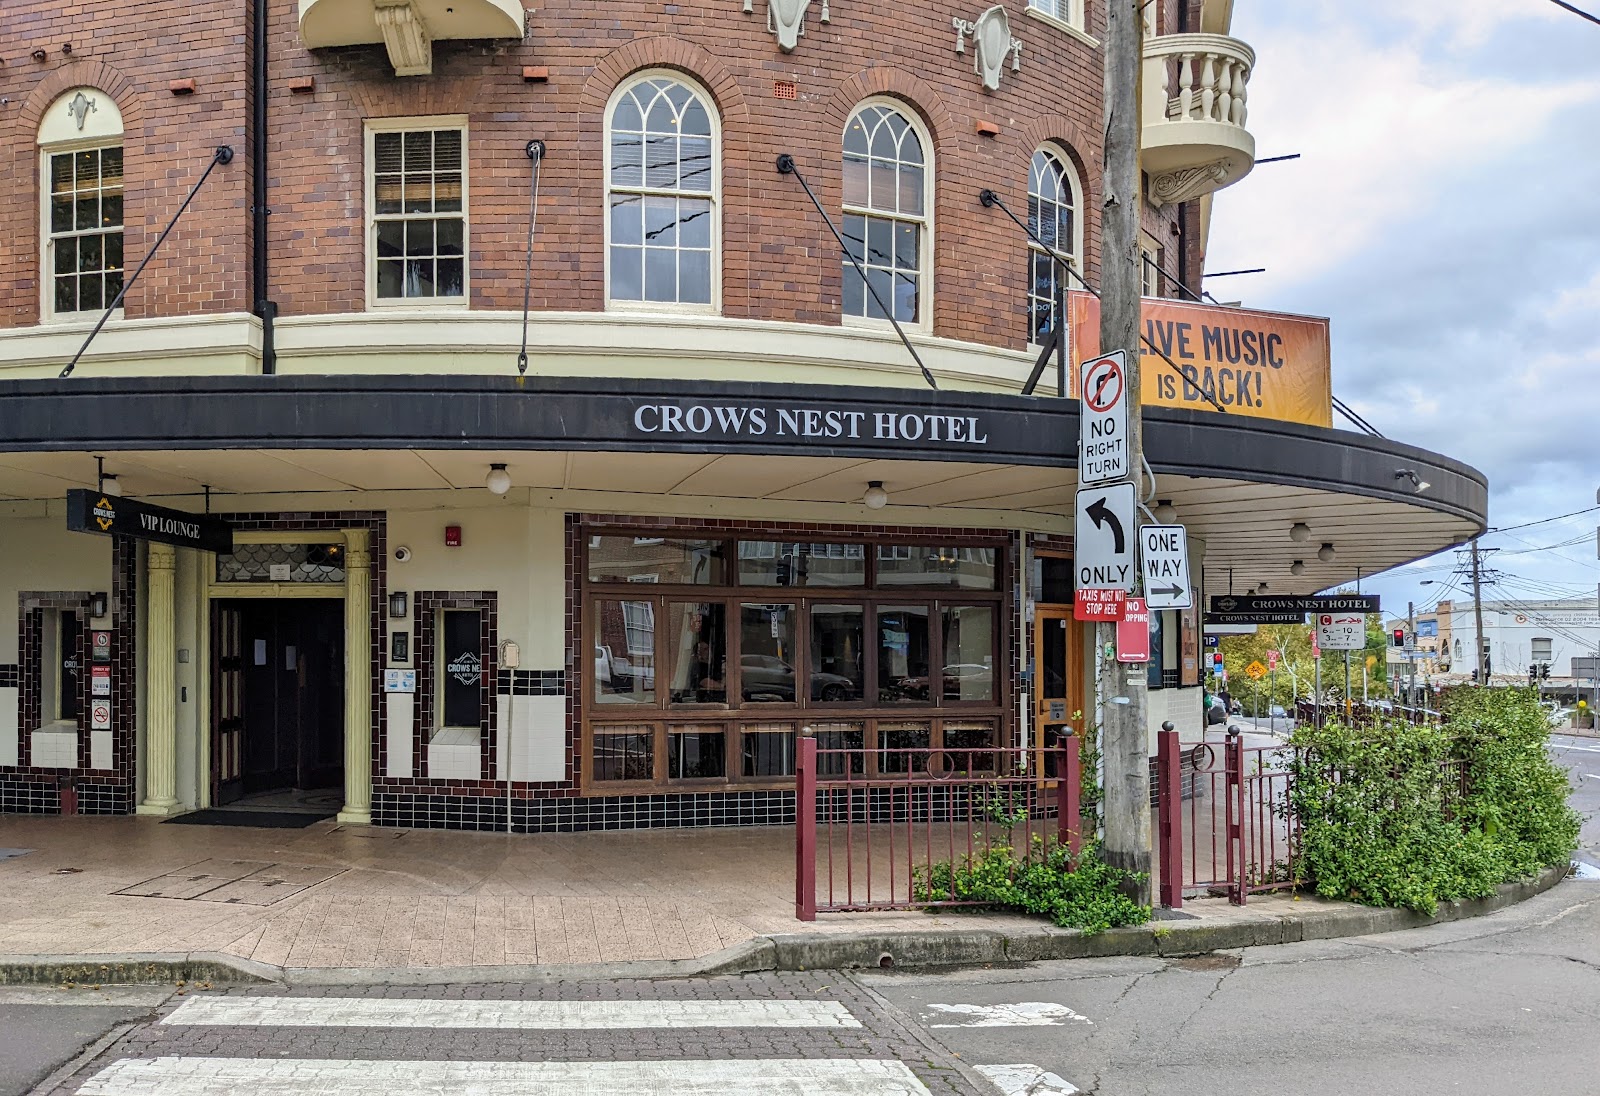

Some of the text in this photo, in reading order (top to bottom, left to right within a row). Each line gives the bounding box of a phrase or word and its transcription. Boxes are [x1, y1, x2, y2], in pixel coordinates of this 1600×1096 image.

[1140, 319, 1284, 369] IVE MUSIC
[1158, 364, 1263, 408] IS BACK!
[634, 404, 988, 444] CROWS NEST HOTEL
[1091, 418, 1115, 439] NO
[1086, 439, 1122, 457] RIGHT
[1087, 458, 1120, 474] TURN
[140, 513, 200, 539] VIP LOUNGE
[1148, 533, 1179, 552] ONE
[1081, 564, 1129, 584] ONLY
[1147, 559, 1182, 577] WAY
[1079, 590, 1124, 602] TAXIS MUST NOT
[1252, 600, 1371, 609] CROWS NEST HOTEL
[1086, 602, 1117, 615] STOP HERE
[1126, 601, 1139, 611] NO
[1125, 613, 1148, 622] OPPING
[447, 663, 480, 672] CROWS NE
